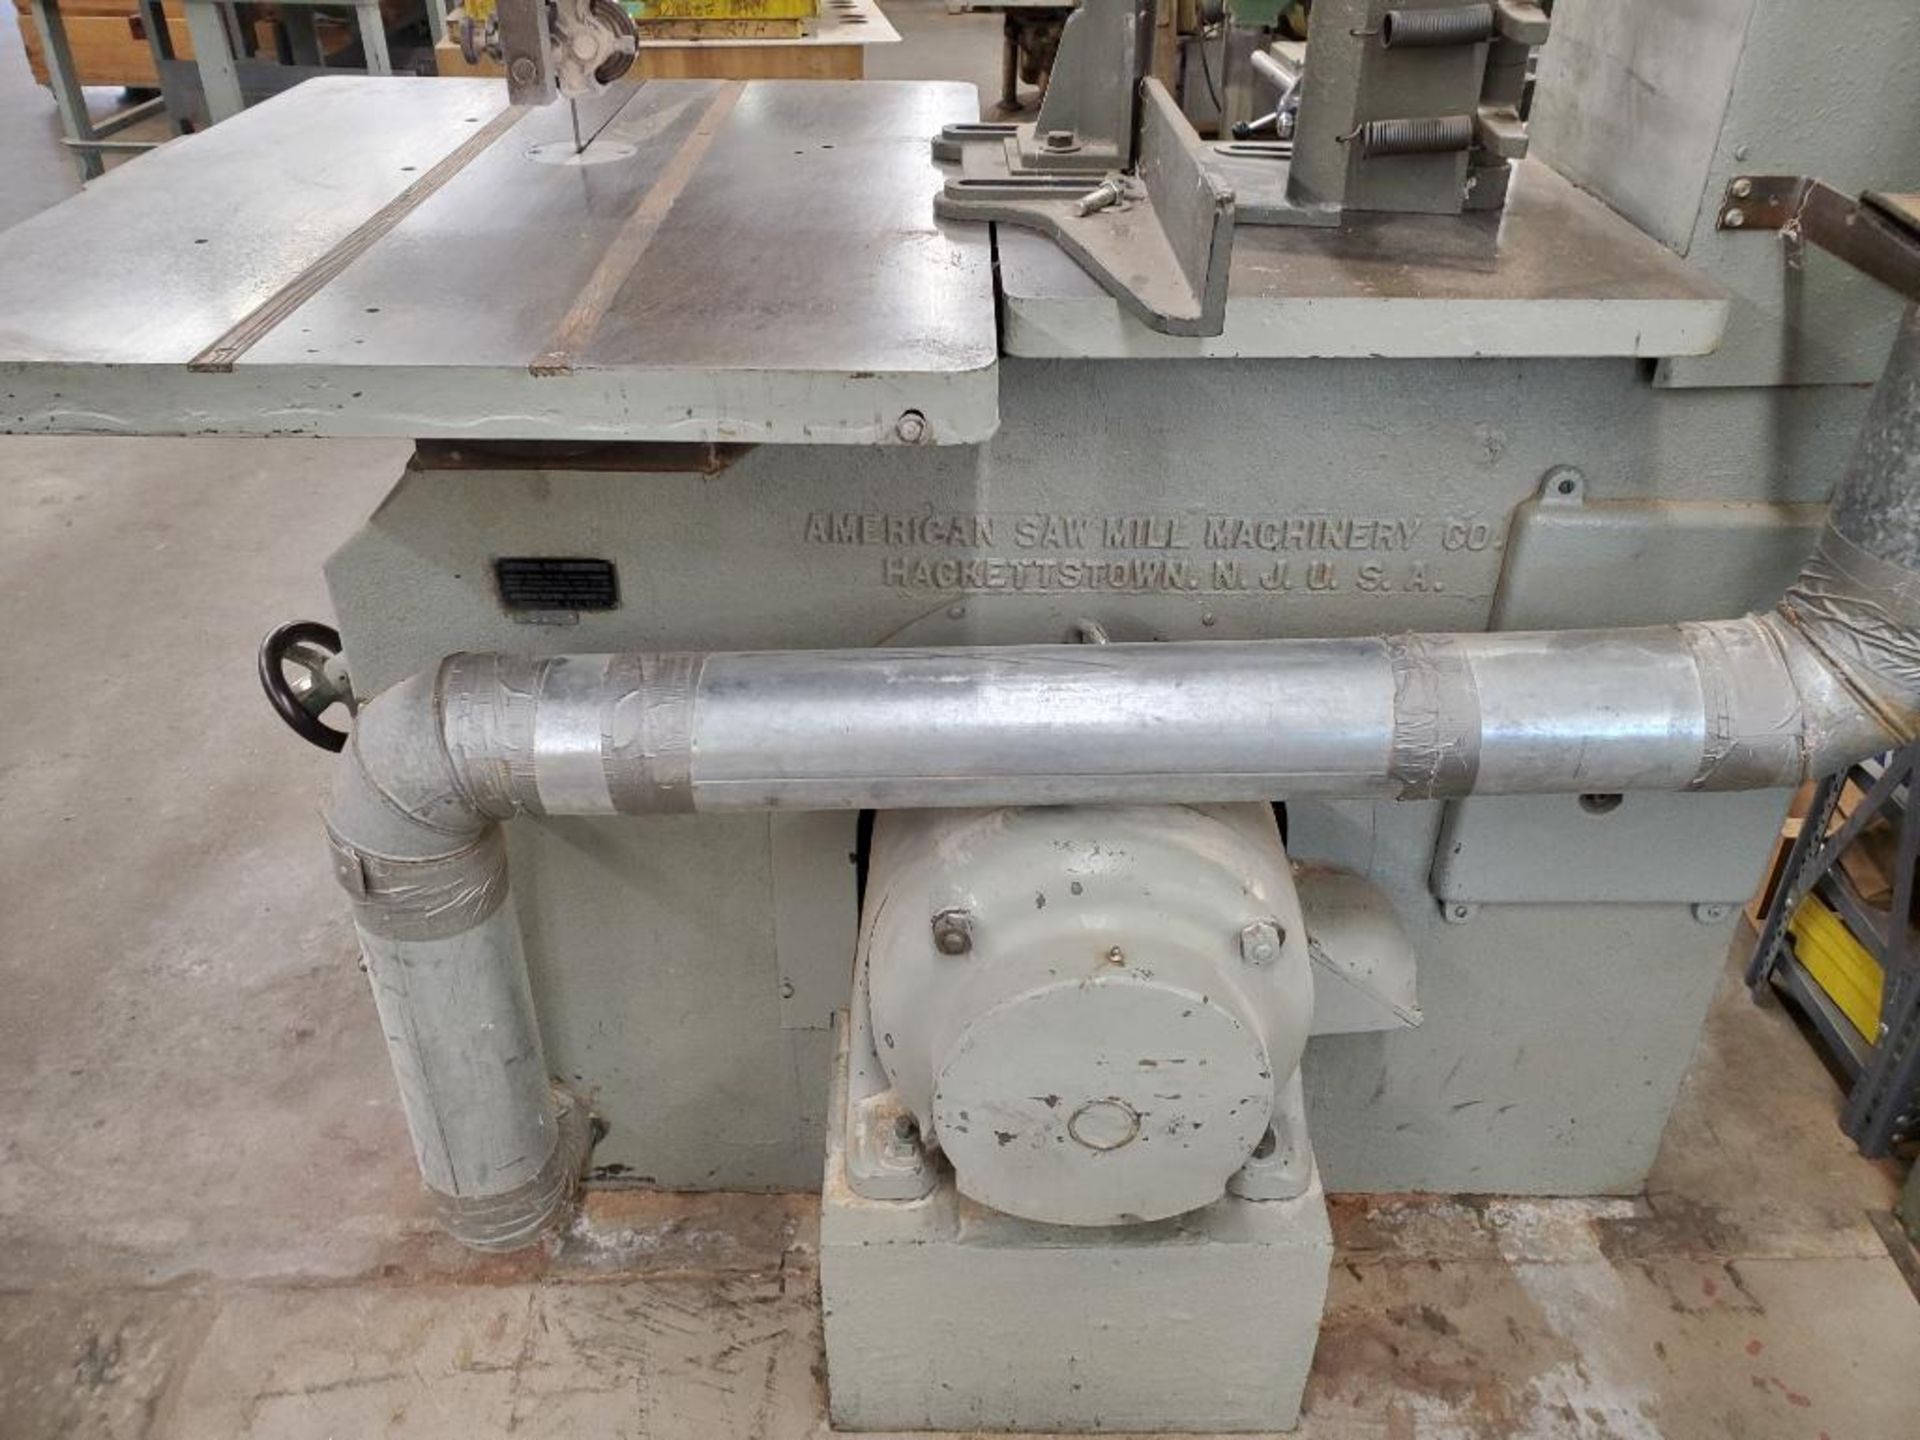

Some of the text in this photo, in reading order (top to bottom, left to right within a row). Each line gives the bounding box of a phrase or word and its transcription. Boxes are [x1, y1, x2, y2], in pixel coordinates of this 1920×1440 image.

[804, 512, 993, 547] AMERICAN
[1016, 514, 1087, 549] SAW
[1102, 517, 1190, 550] MILL
[1204, 515, 1422, 551] MACHINERY
[1212, 560, 1248, 591] N.
[1259, 560, 1291, 592] J.
[1305, 560, 1338, 592] U.
[1355, 560, 1392, 593] S.
[1402, 560, 1445, 593] A.
